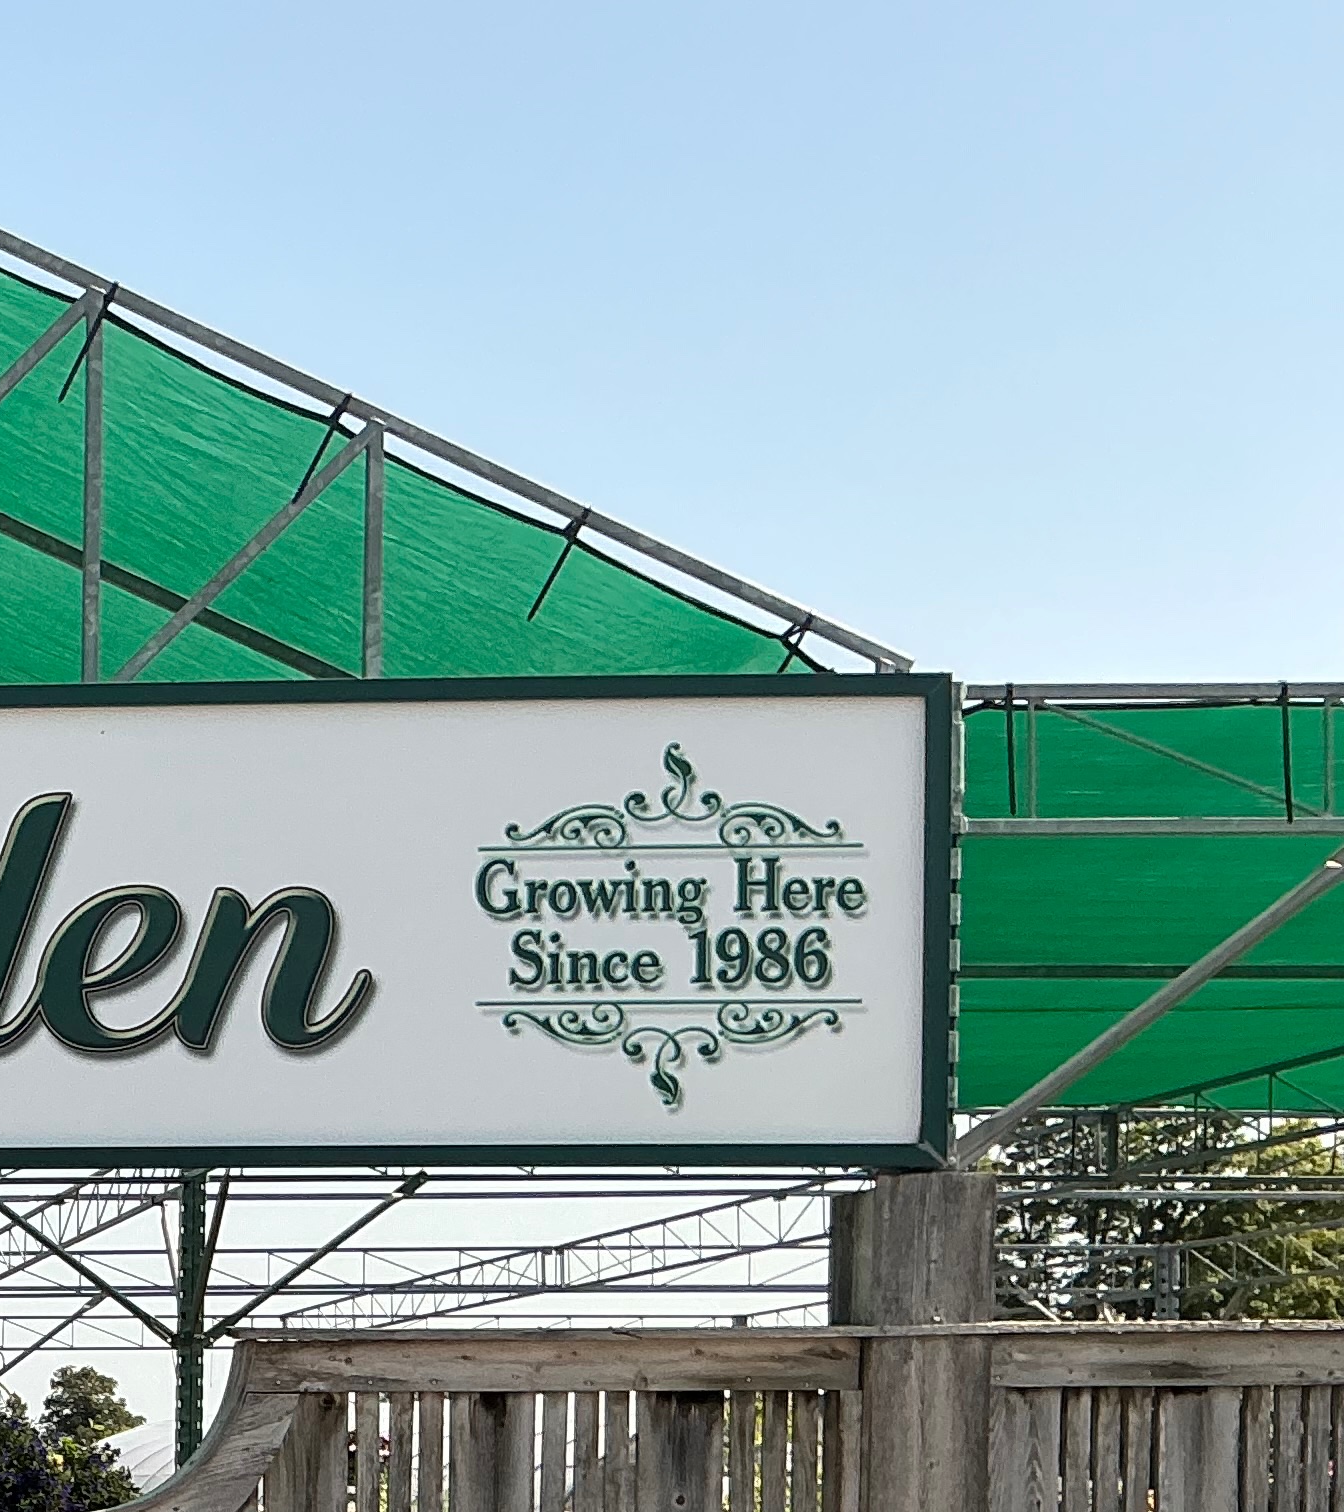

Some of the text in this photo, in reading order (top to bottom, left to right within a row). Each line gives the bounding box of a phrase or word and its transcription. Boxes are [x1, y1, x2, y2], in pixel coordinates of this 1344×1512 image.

[476, 856, 864, 924] Growing Here
[509, 926, 831, 985] Since 1986
